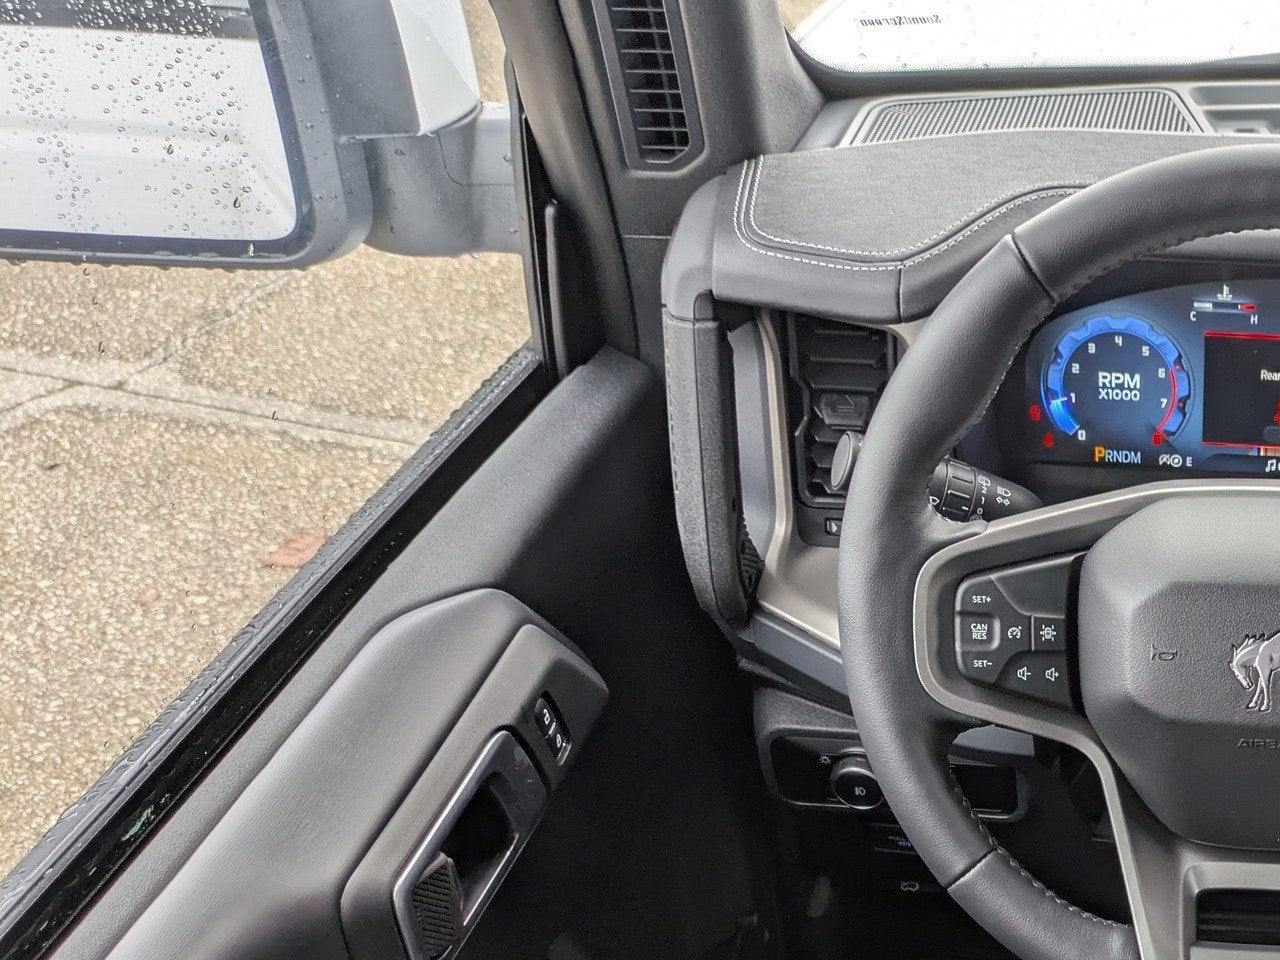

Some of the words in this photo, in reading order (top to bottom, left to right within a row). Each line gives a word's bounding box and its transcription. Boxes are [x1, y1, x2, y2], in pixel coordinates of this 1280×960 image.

[1190, 311, 1197, 321] C
[1250, 315, 1258, 325] H
[1114, 336, 1123, 346] 4
[1088, 343, 1096, 353] 3
[1142, 346, 1150, 357] 5
[1072, 363, 1080, 373] 2
[1158, 368, 1166, 379] 6
[1260, 369, 1280, 381] Rear
[1098, 371, 1141, 389] RPM
[1070, 393, 1076, 403] 1
[1099, 389, 1140, 401] X1000
[1160, 398, 1168, 409] 7
[1077, 429, 1086, 441] 0
[1186, 456, 1193, 467] E
[972, 595, 992, 604] SET+
[970, 623, 988, 631] CAN
[972, 632, 987, 640] RES
